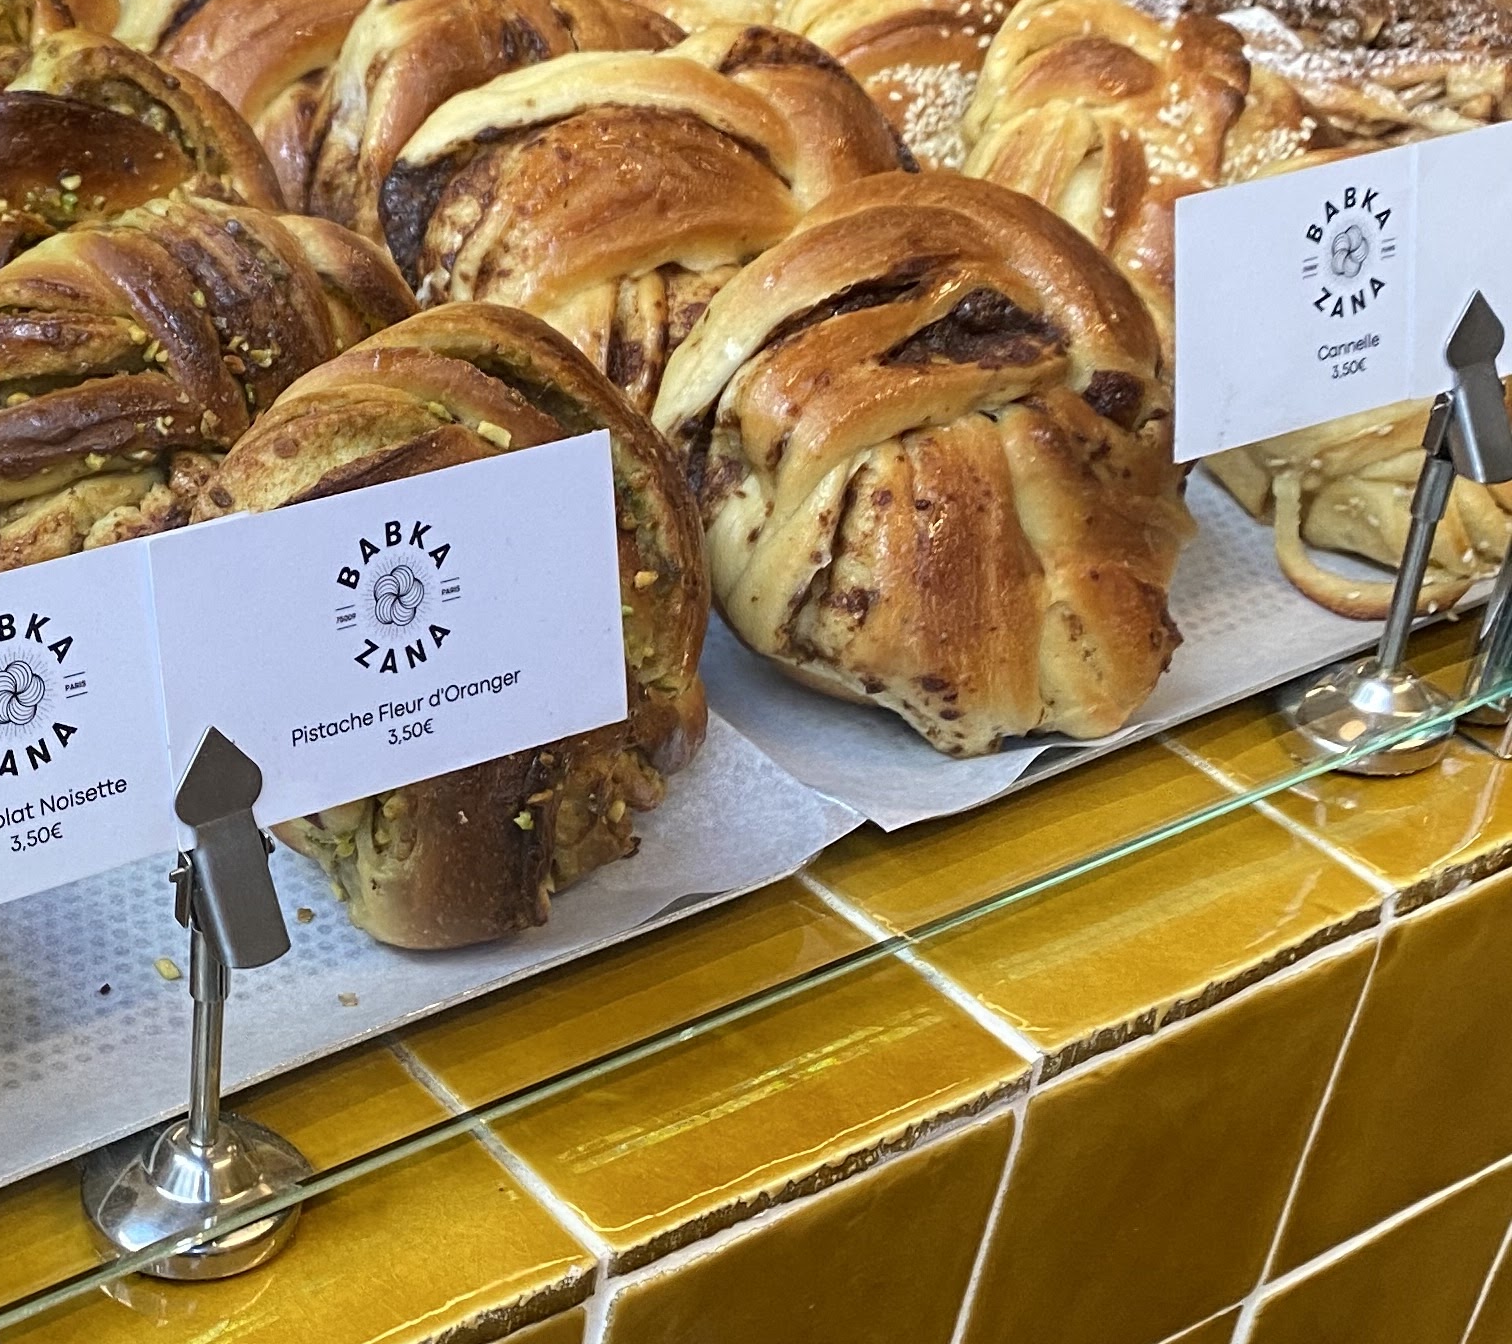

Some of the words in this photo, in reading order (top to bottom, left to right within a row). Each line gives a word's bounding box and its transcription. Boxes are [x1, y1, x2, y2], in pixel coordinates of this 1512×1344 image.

[1306, 186, 1392, 244] BABKA
[1313, 276, 1386, 318] ZANA
[1317, 333, 1380, 361] Cannelle
[336, 520, 452, 590] BABKA
[354, 623, 452, 674] ZANA
[291, 711, 374, 747] Pistache
[379, 695, 424, 723] Fleur
[429, 669, 522, 708] d'Oranger
[388, 718, 435, 746] 3,50€
[39, 778, 128, 817] Noisette
[10, 822, 64, 852] 3,50€
